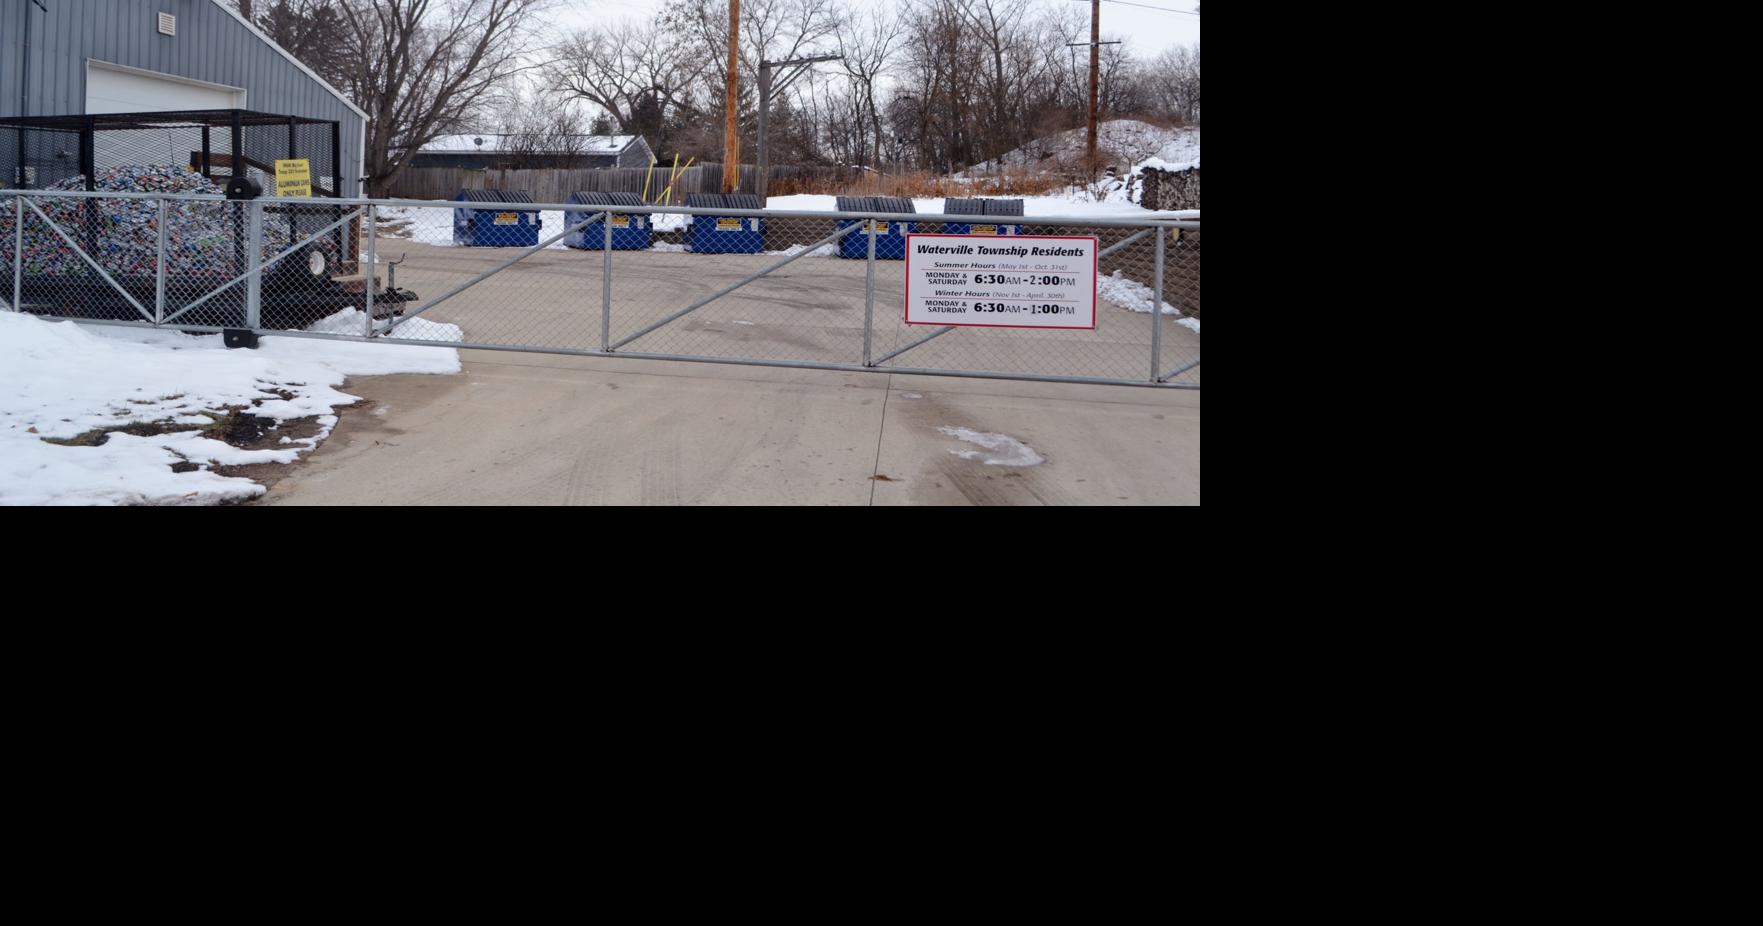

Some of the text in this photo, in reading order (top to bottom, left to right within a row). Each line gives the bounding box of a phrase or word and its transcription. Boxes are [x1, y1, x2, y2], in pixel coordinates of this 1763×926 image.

[917, 244, 1085, 258] Waterville Township Residents
[998, 263, 1016, 271] (May
[928, 278, 968, 286] SATURDAY
[965, 290, 990, 298] Hours
[927, 306, 967, 314] SATURDAY
